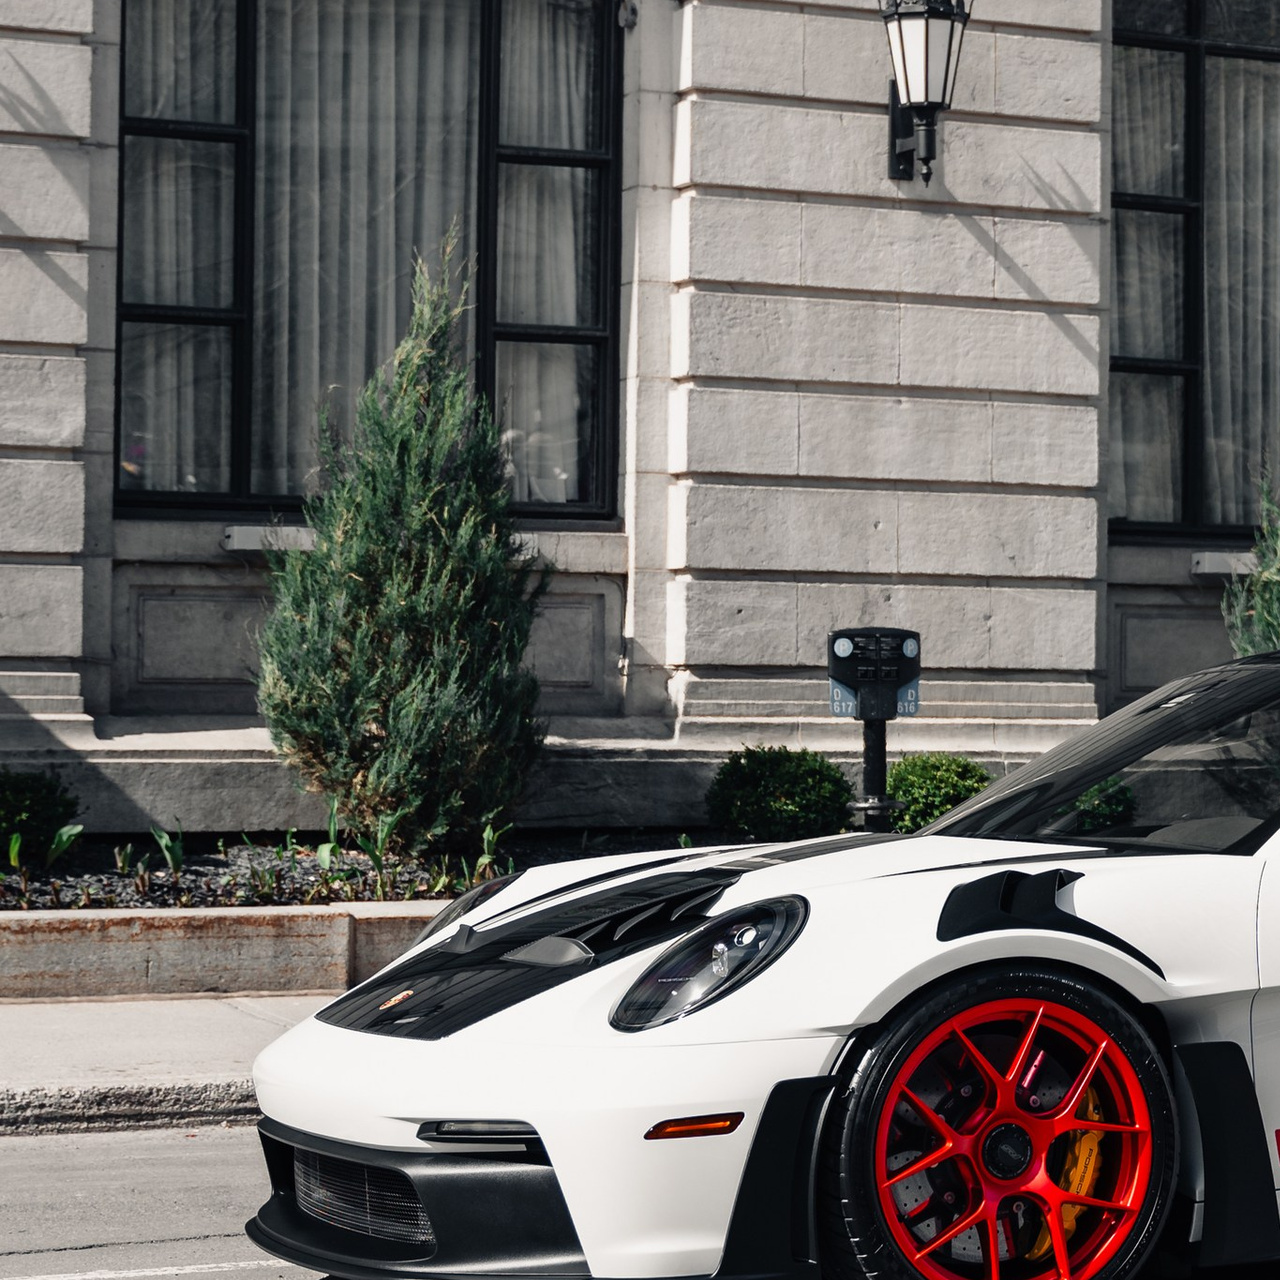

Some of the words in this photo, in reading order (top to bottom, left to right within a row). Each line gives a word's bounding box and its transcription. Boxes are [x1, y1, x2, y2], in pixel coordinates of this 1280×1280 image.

[839, 641, 848, 654] P
[908, 641, 915, 654] P
[833, 702, 853, 713] 617
[897, 702, 915, 713] 616
[1071, 1148, 1093, 1209] PORSCH
